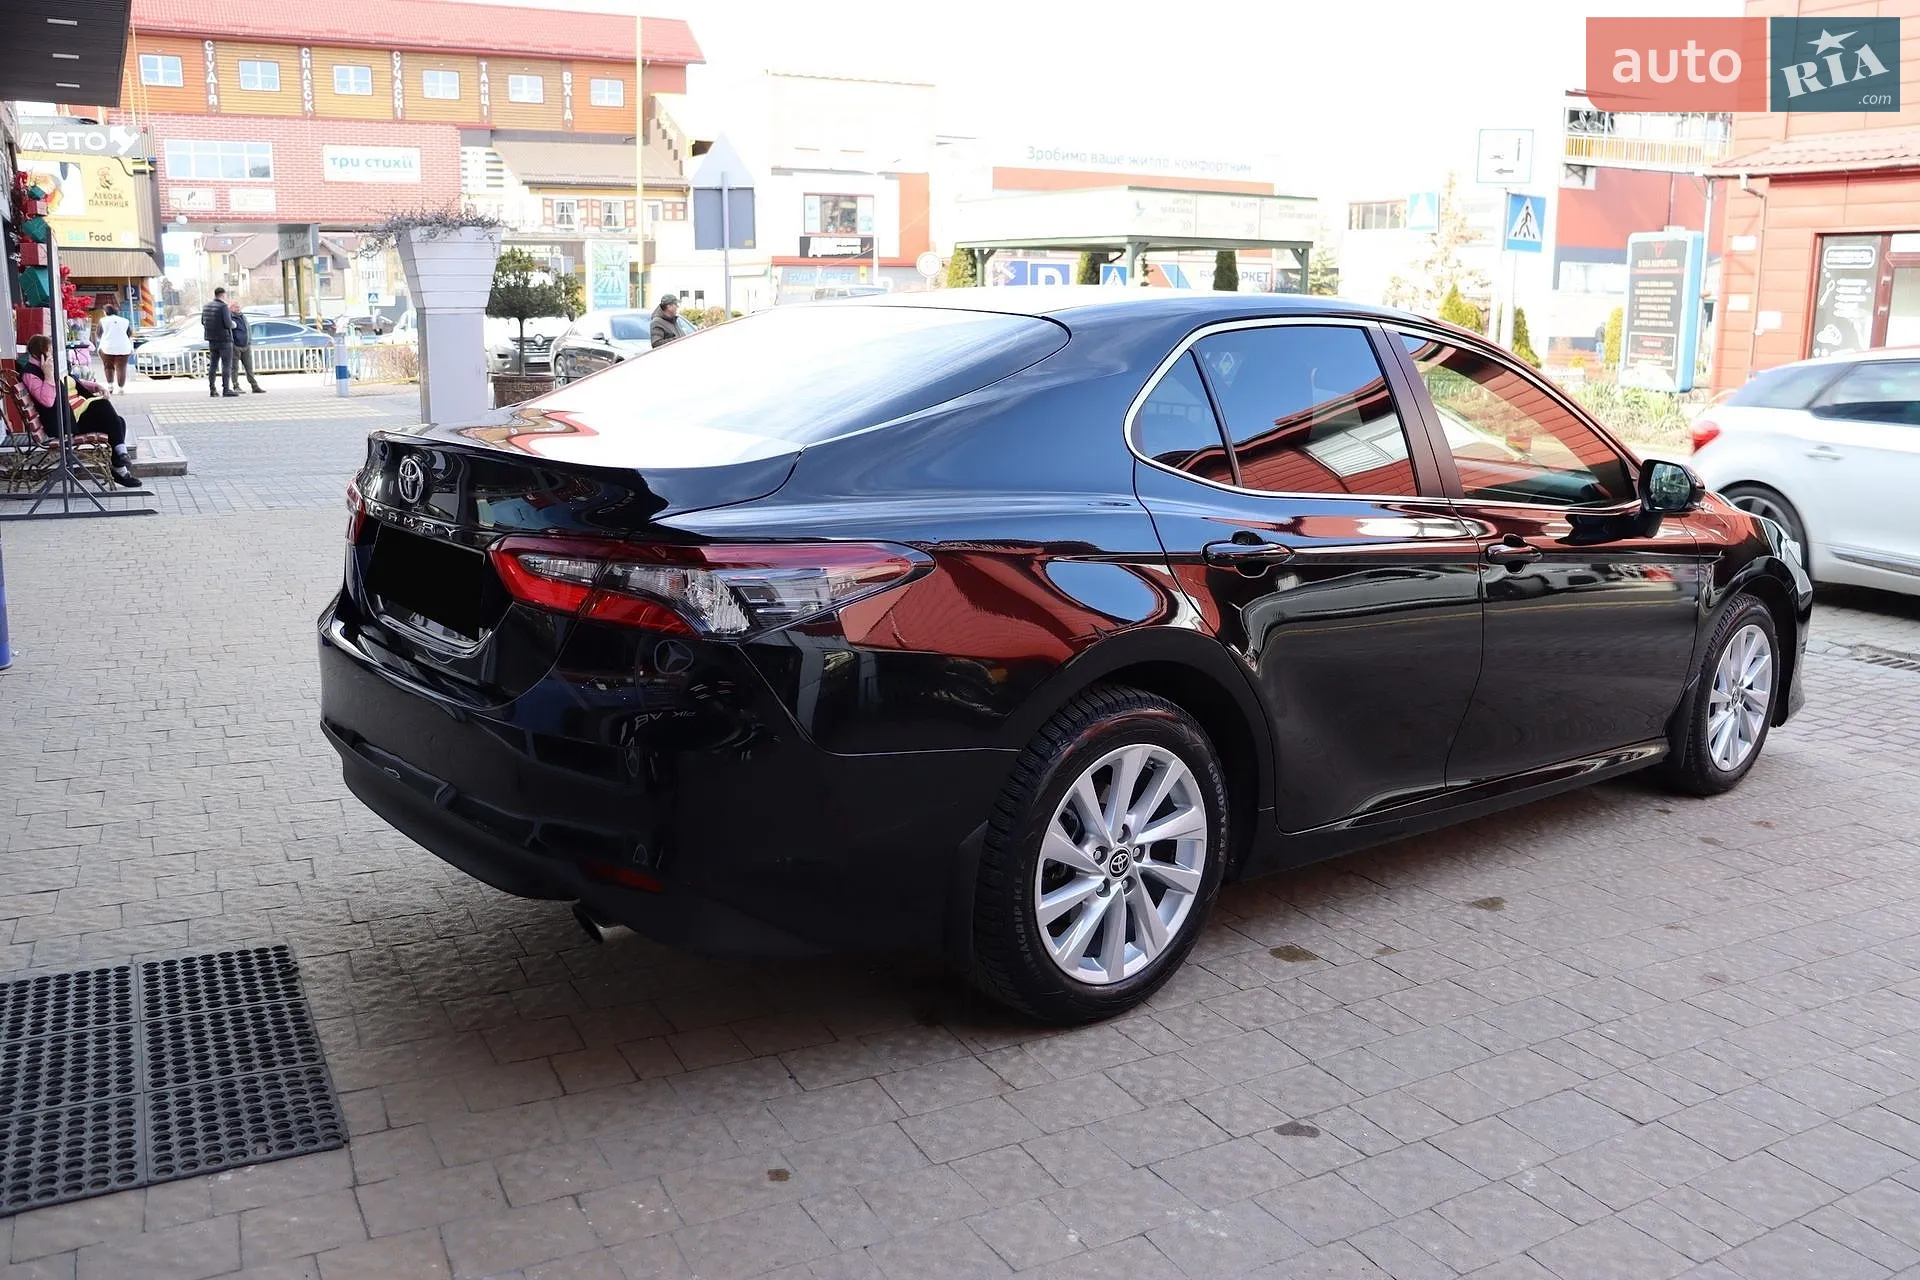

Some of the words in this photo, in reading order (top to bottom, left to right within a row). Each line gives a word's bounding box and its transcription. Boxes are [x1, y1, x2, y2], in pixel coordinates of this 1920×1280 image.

[205, 40, 217, 105] СТУДІЯ
[302, 47, 313, 112] СПЛЕСК
[1026, 146, 1087, 163] Зробимо
[1091, 152, 1123, 165] ваше
[88, 231, 113, 242] Food
